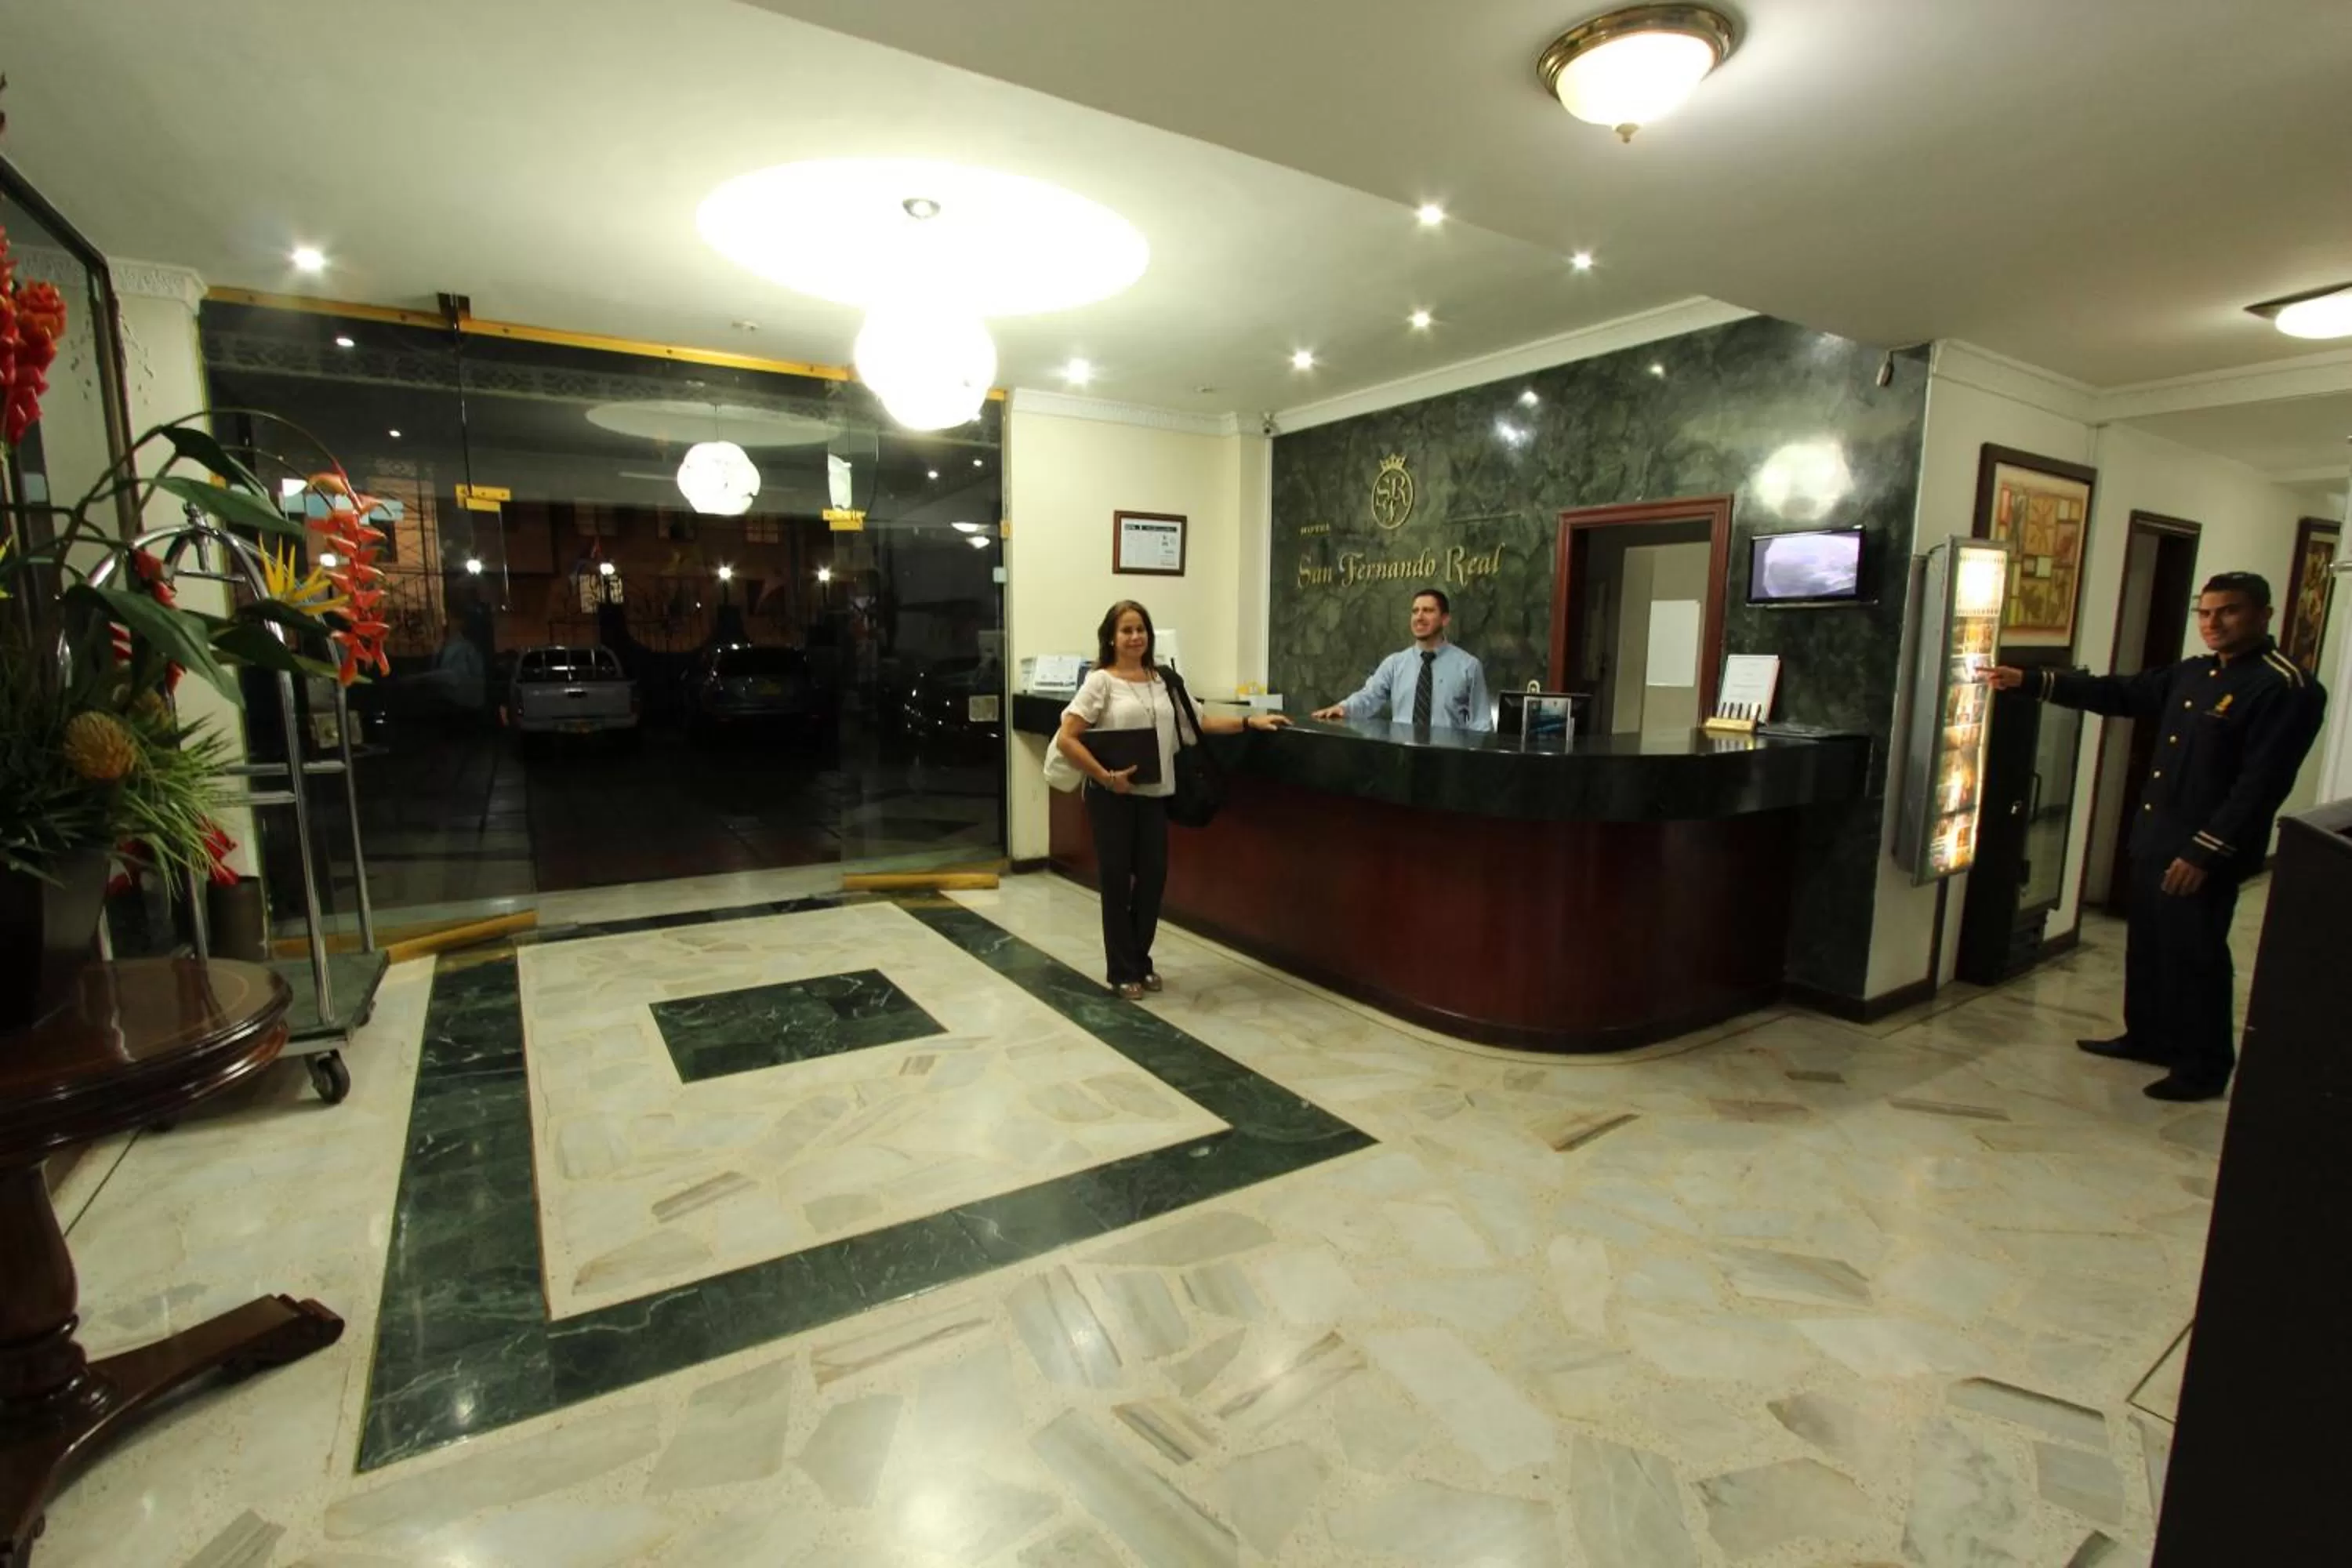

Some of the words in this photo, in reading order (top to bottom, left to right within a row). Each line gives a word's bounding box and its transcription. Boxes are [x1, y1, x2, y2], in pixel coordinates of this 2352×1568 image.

[1297, 552, 1333, 590] San
[1338, 547, 1436, 588] Fernando
[1445, 542, 1506, 590] Real
